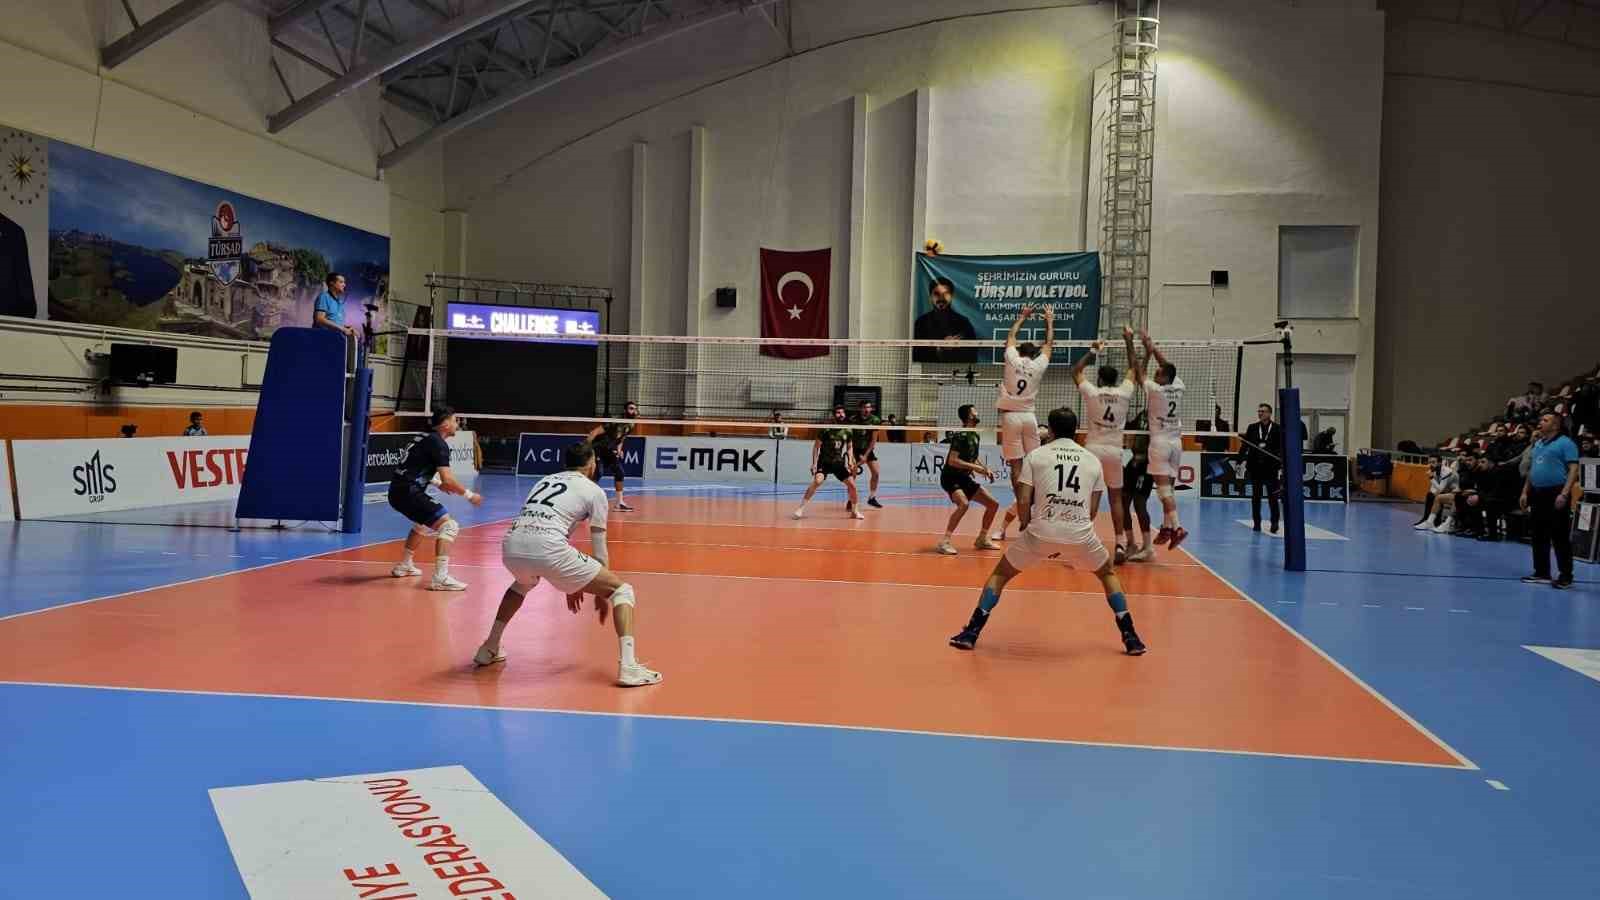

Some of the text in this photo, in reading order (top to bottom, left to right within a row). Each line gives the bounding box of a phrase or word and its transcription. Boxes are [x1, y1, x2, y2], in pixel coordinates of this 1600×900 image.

[977, 271, 1080, 282] ŞEHRİMİZİN GURURU
[974, 281, 1089, 301] TÜRŞAD VOLEYBOL
[490, 312, 559, 335] CHALLENGE
[1016, 379, 1028, 395] 9
[1103, 405, 1115, 422] 4
[1167, 401, 1177, 417] 2
[166, 448, 250, 490] VESTE
[655, 447, 768, 473] E-MAK
[1054, 463, 1081, 493] 14
[526, 481, 568, 508] 22
